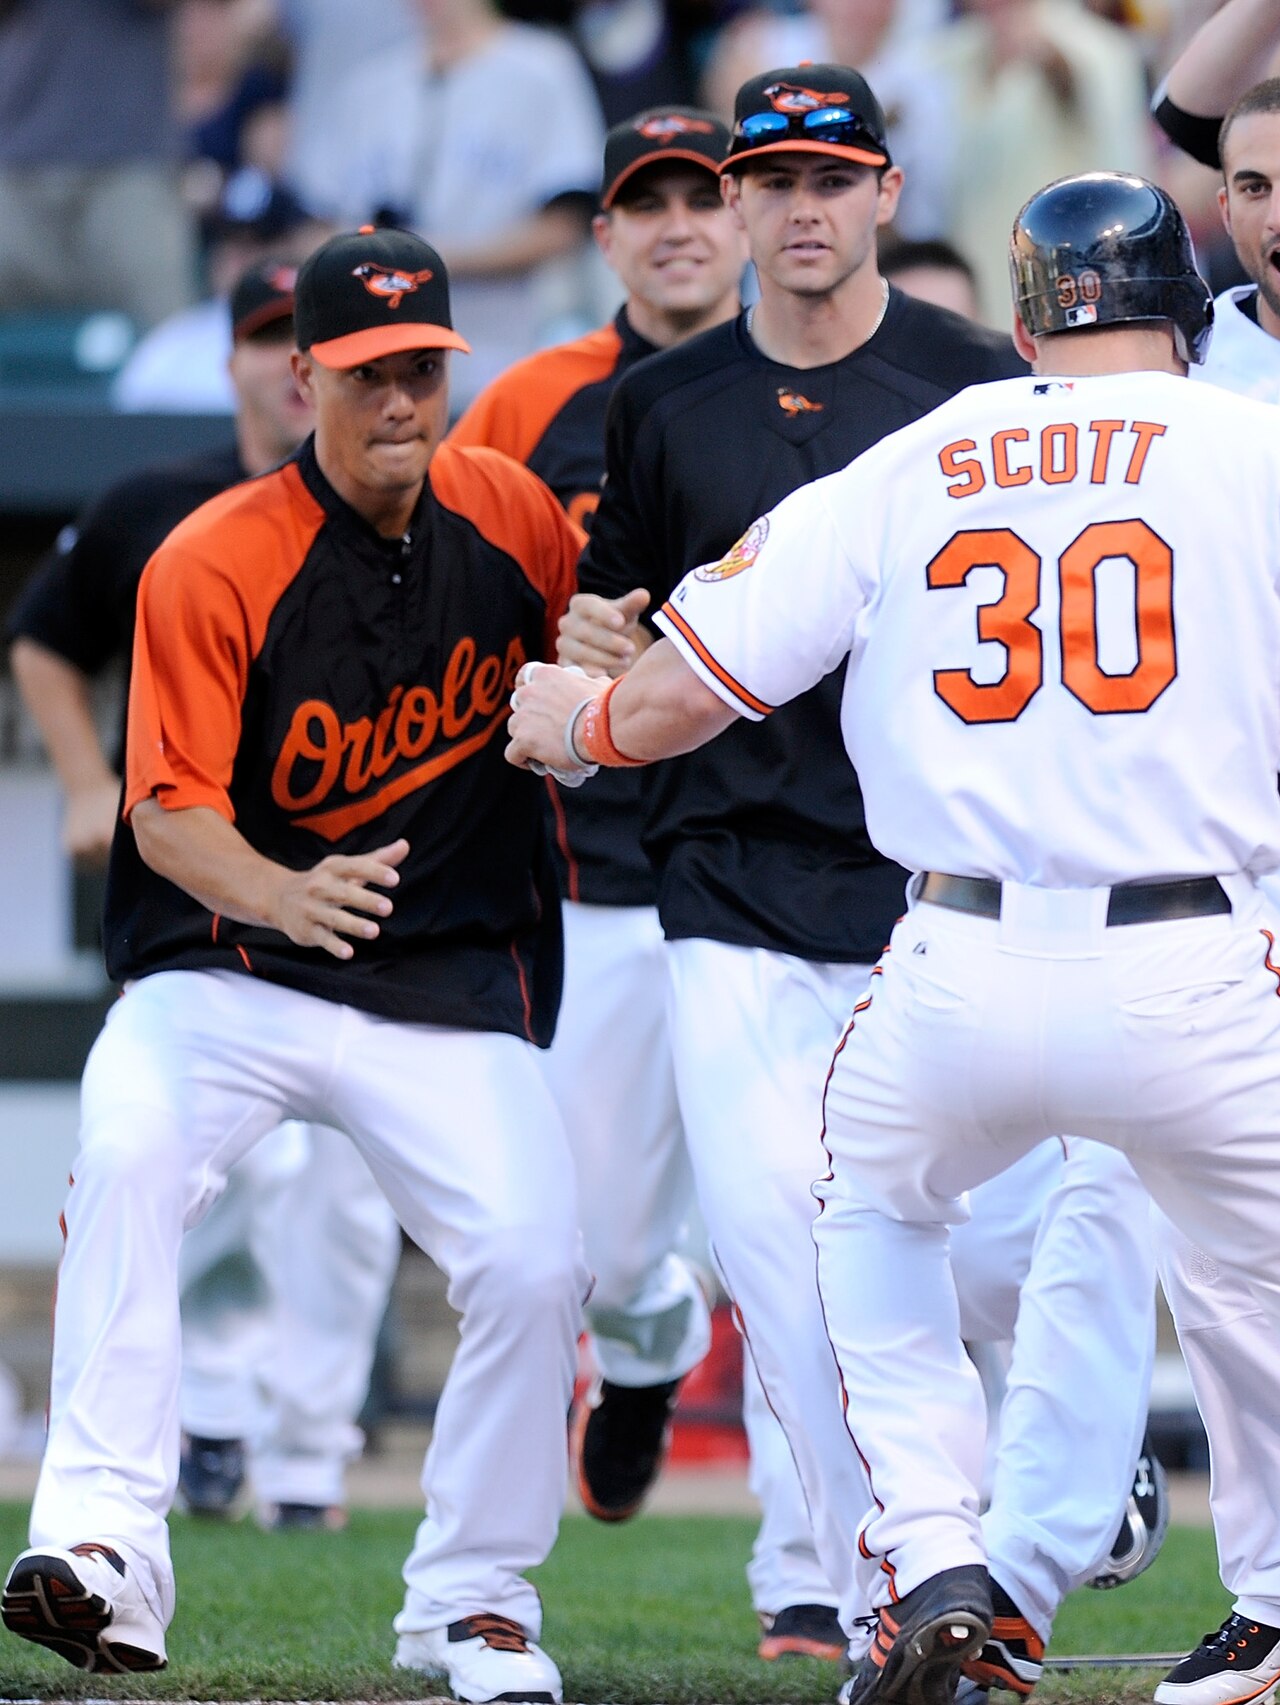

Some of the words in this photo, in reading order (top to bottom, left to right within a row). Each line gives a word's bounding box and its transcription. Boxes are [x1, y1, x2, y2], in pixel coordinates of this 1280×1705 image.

[1055, 268, 1102, 307] 30
[938, 419, 1168, 499] SCOTT
[925, 518, 1178, 726] 30
